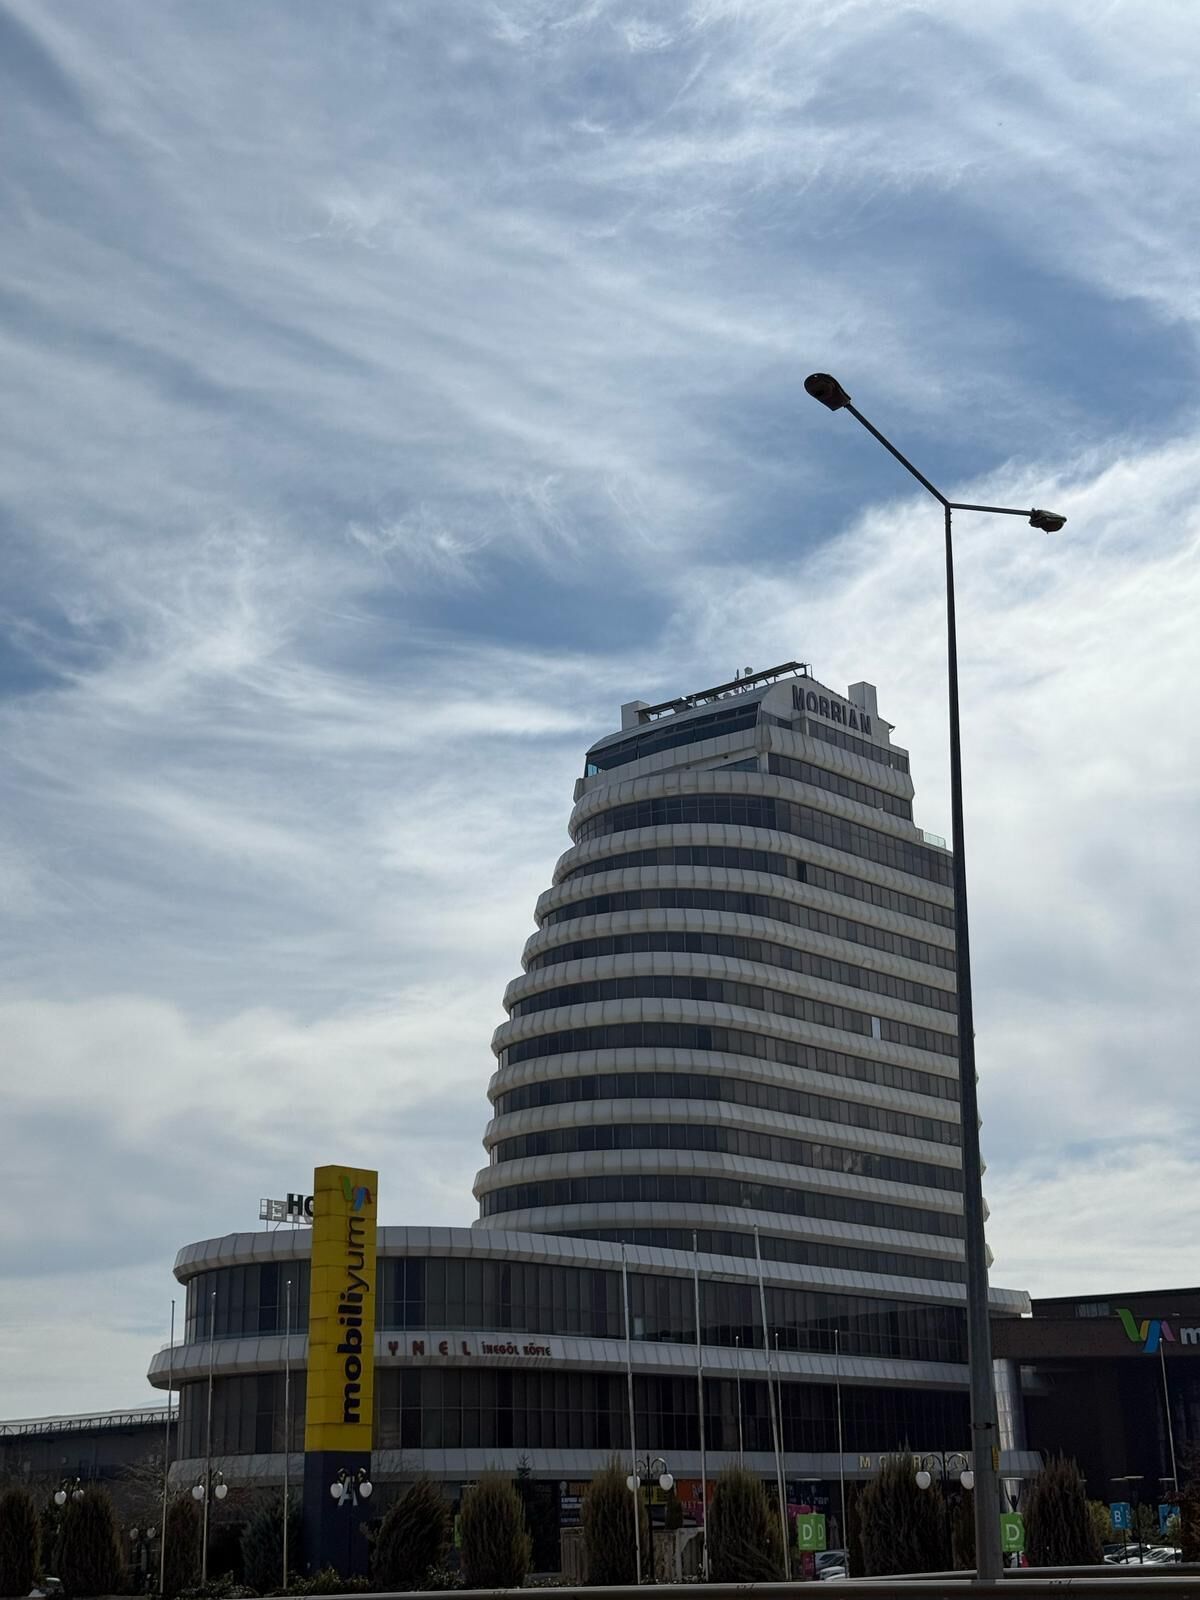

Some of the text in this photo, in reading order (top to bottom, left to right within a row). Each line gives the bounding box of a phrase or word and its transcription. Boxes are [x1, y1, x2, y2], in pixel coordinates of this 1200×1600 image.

[337, 1216, 369, 1423] mobiliyum
[338, 1476, 358, 1506] A
[803, 1524, 812, 1540] D
[1005, 1524, 1020, 1541] D
